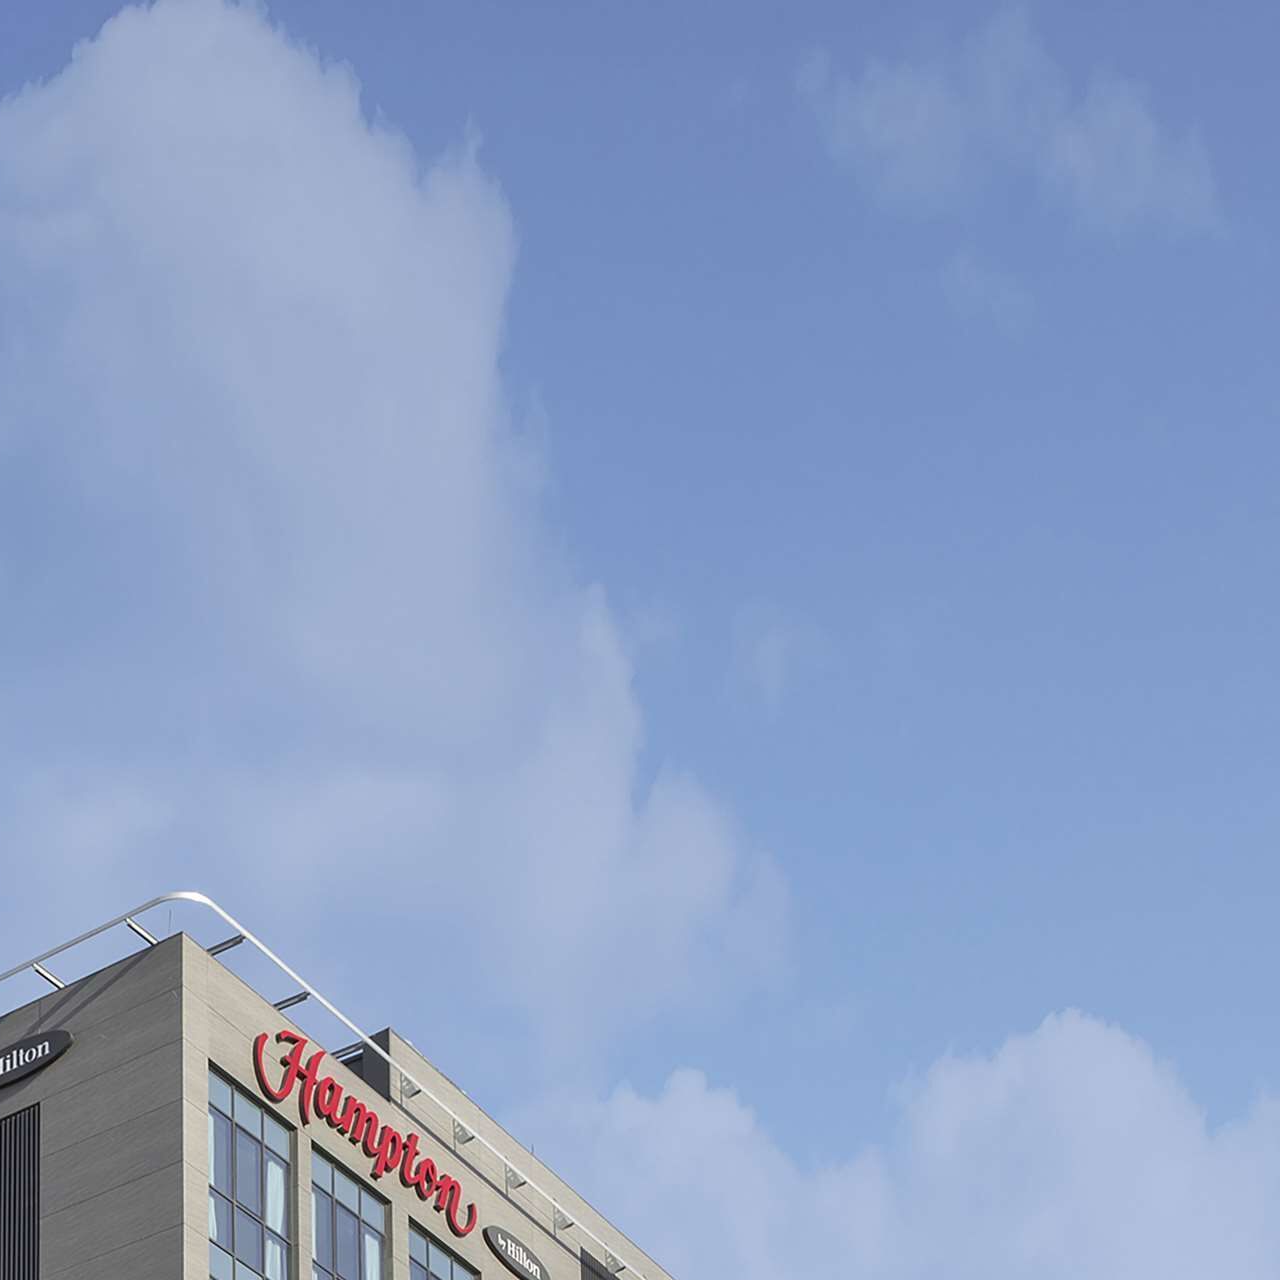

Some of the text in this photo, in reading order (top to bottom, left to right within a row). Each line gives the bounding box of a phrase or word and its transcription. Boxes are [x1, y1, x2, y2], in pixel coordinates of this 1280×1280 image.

[252, 1030, 541, 1280] Hampton by Hilton
